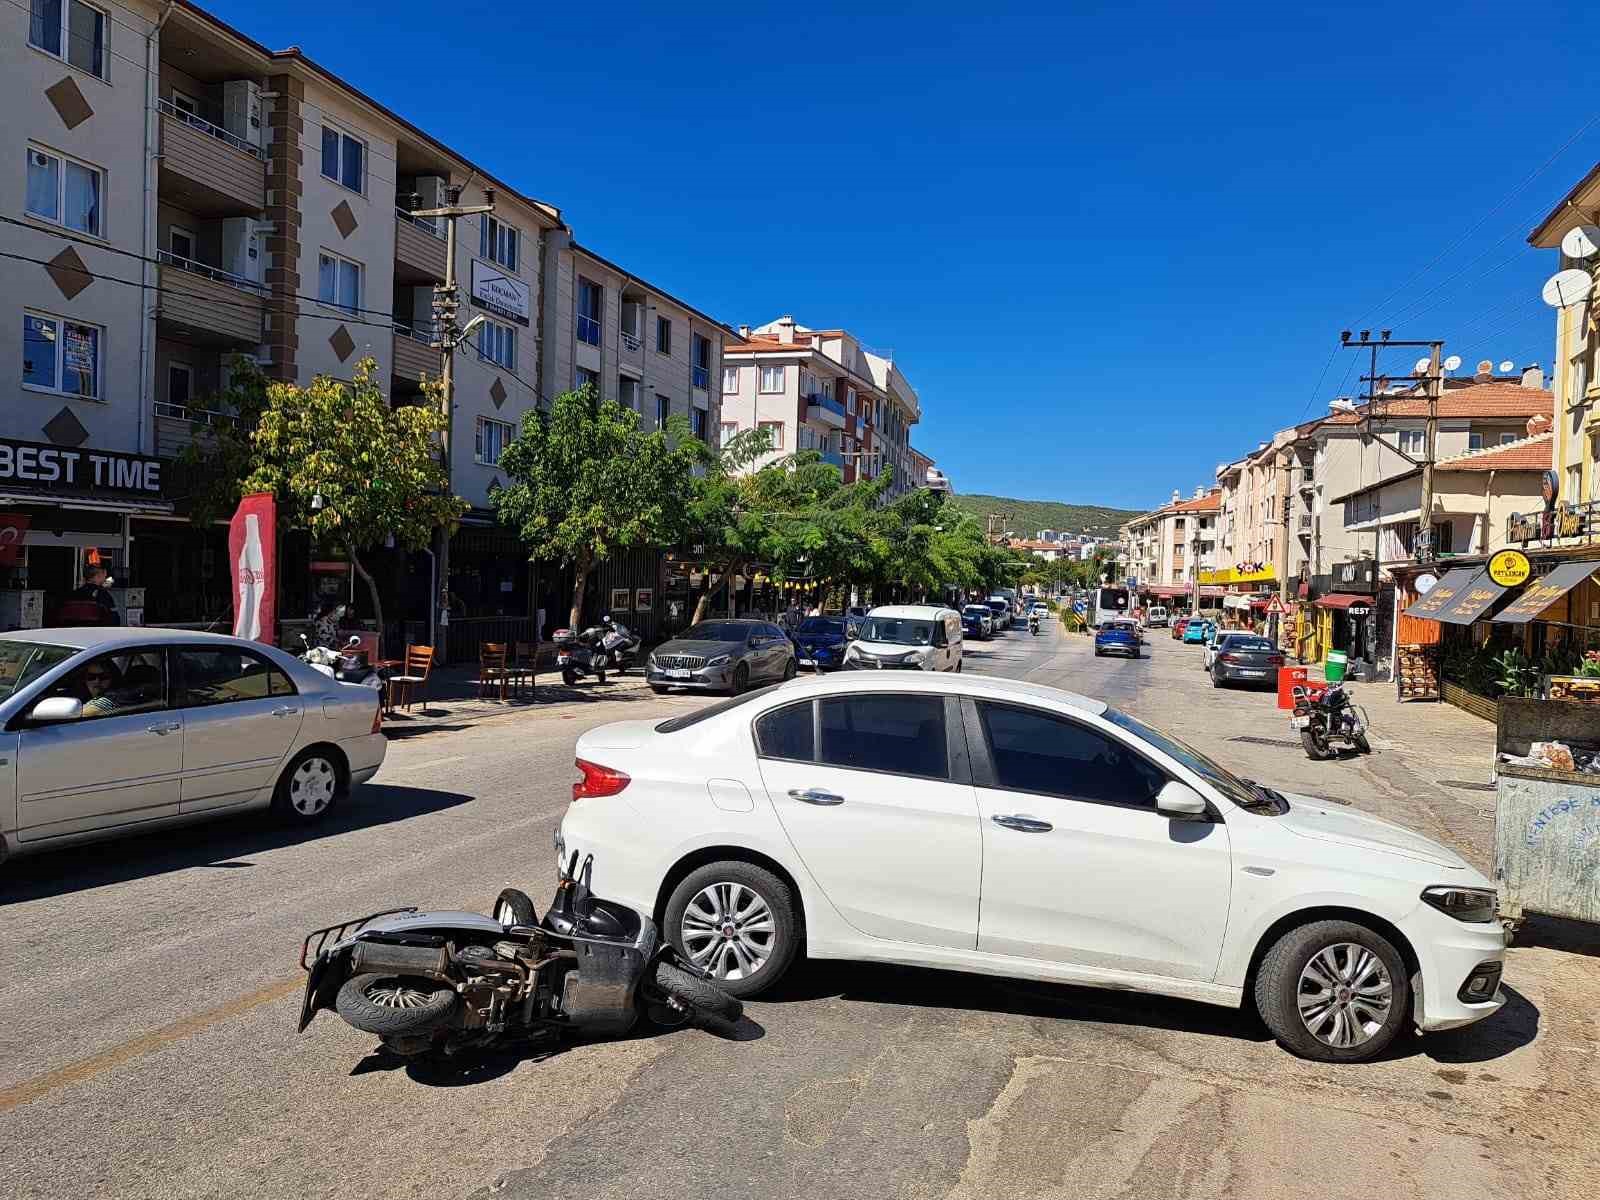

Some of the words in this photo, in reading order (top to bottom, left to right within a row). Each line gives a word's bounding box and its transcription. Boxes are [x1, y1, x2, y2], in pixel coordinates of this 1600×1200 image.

[0, 444, 80, 483] BEST
[89, 454, 161, 491] TIME
[1348, 607, 1370, 615] REST
